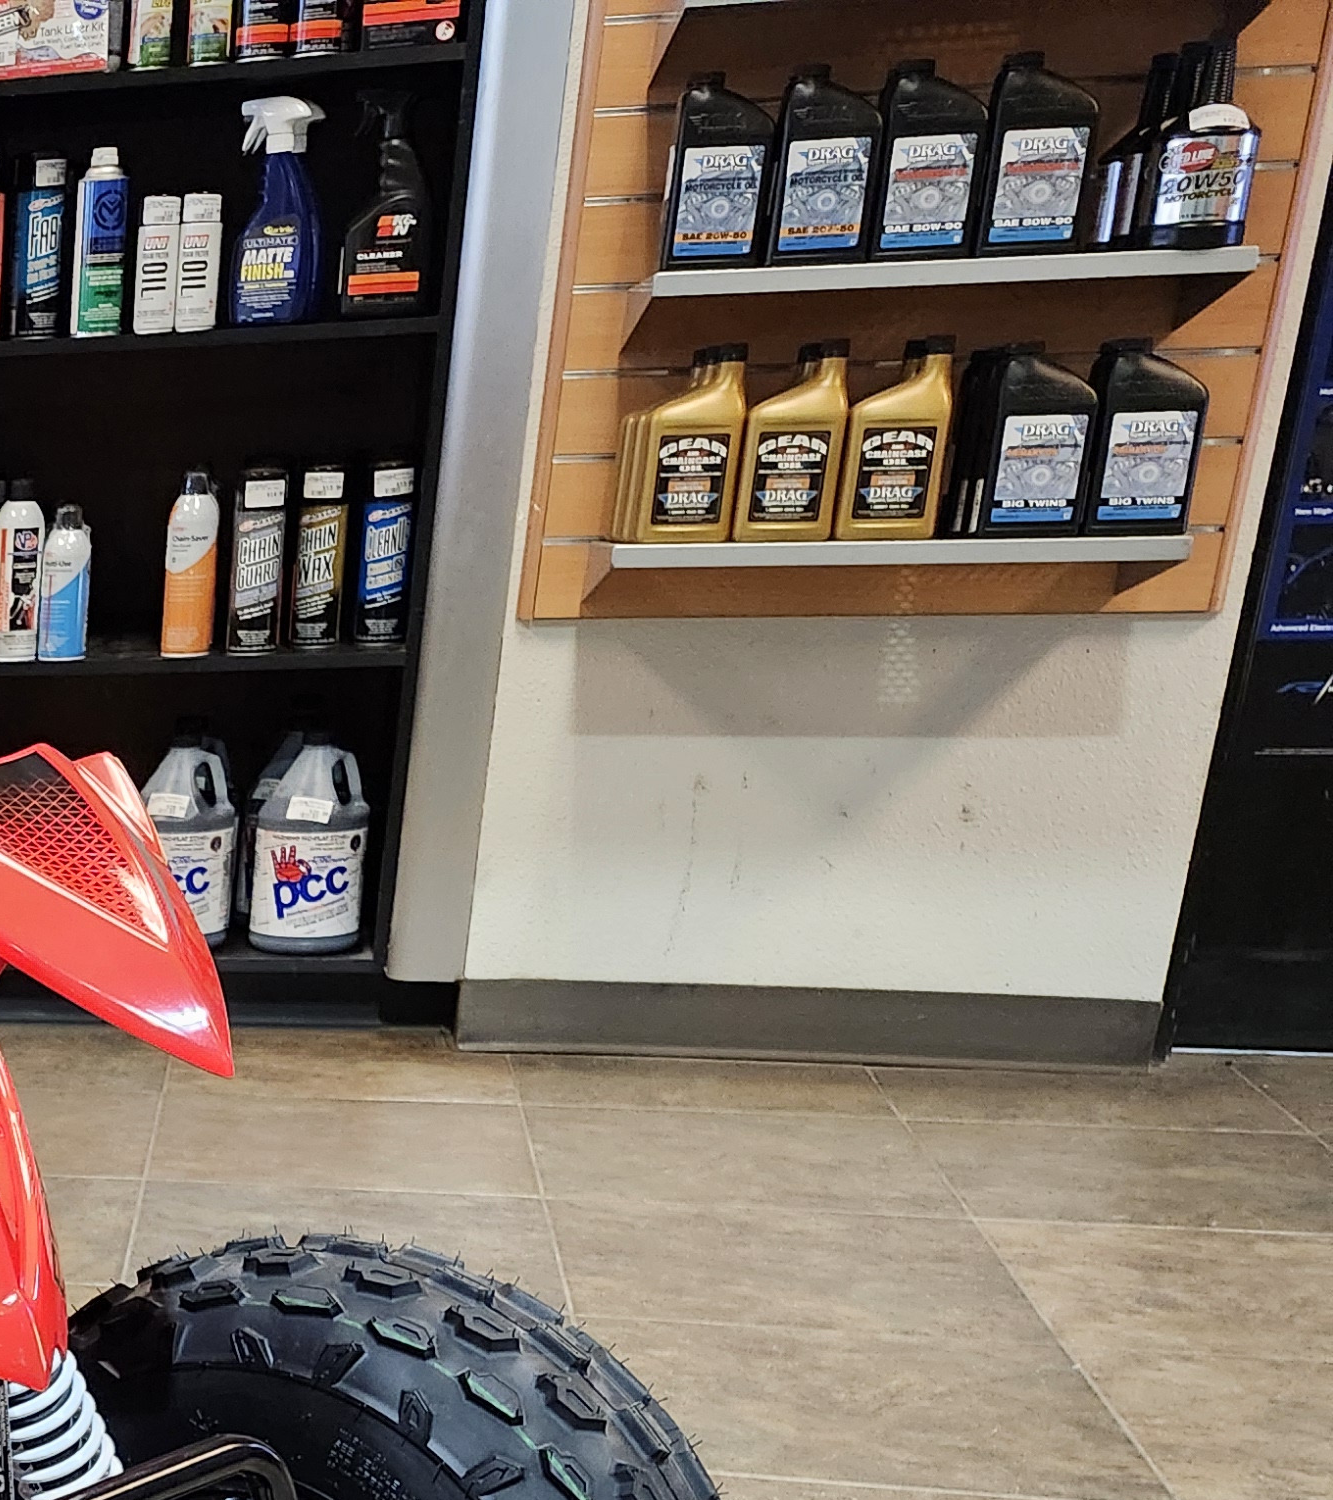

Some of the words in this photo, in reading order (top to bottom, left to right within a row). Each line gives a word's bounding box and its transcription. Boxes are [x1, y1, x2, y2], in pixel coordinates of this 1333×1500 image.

[40, 25, 63, 36] Tank
[91, 21, 105, 32] Kit
[909, 143, 957, 159] DRAG
[1019, 136, 1068, 151] DRAG
[701, 154, 748, 168] DRAG
[807, 146, 854, 161] DRAG
[685, 182, 743, 193] MOTORCYCLE
[789, 175, 848, 188] MOTORCYCLE
[885, 223, 910, 233] SAE
[993, 218, 1020, 227] SAE
[682, 233, 703, 241] SAE
[788, 227, 809, 235] SAE
[144, 235, 169, 250] UNI
[183, 234, 209, 249] UNI
[243, 247, 294, 266] MATTE
[240, 264, 284, 282] FINISH
[1023, 424, 1070, 438] DRAG
[1130, 419, 1178, 435] DRAG
[659, 438, 727, 459] GEAR
[758, 434, 827, 455] GEAR
[863, 431, 934, 451] GEAR
[667, 492, 709, 505] DRAG
[765, 490, 808, 502] DRAG
[869, 487, 913, 500] DRAG
[1109, 498, 1133, 506] BIG
[1134, 496, 1176, 505] TWINS
[1002, 500, 1026, 509] BIG
[1027, 499, 1067, 508] TWINS
[239, 530, 282, 566] CHAIN
[236, 558, 280, 591] GUARD
[298, 550, 337, 588] WAX
[273, 866, 350, 920] pcc
